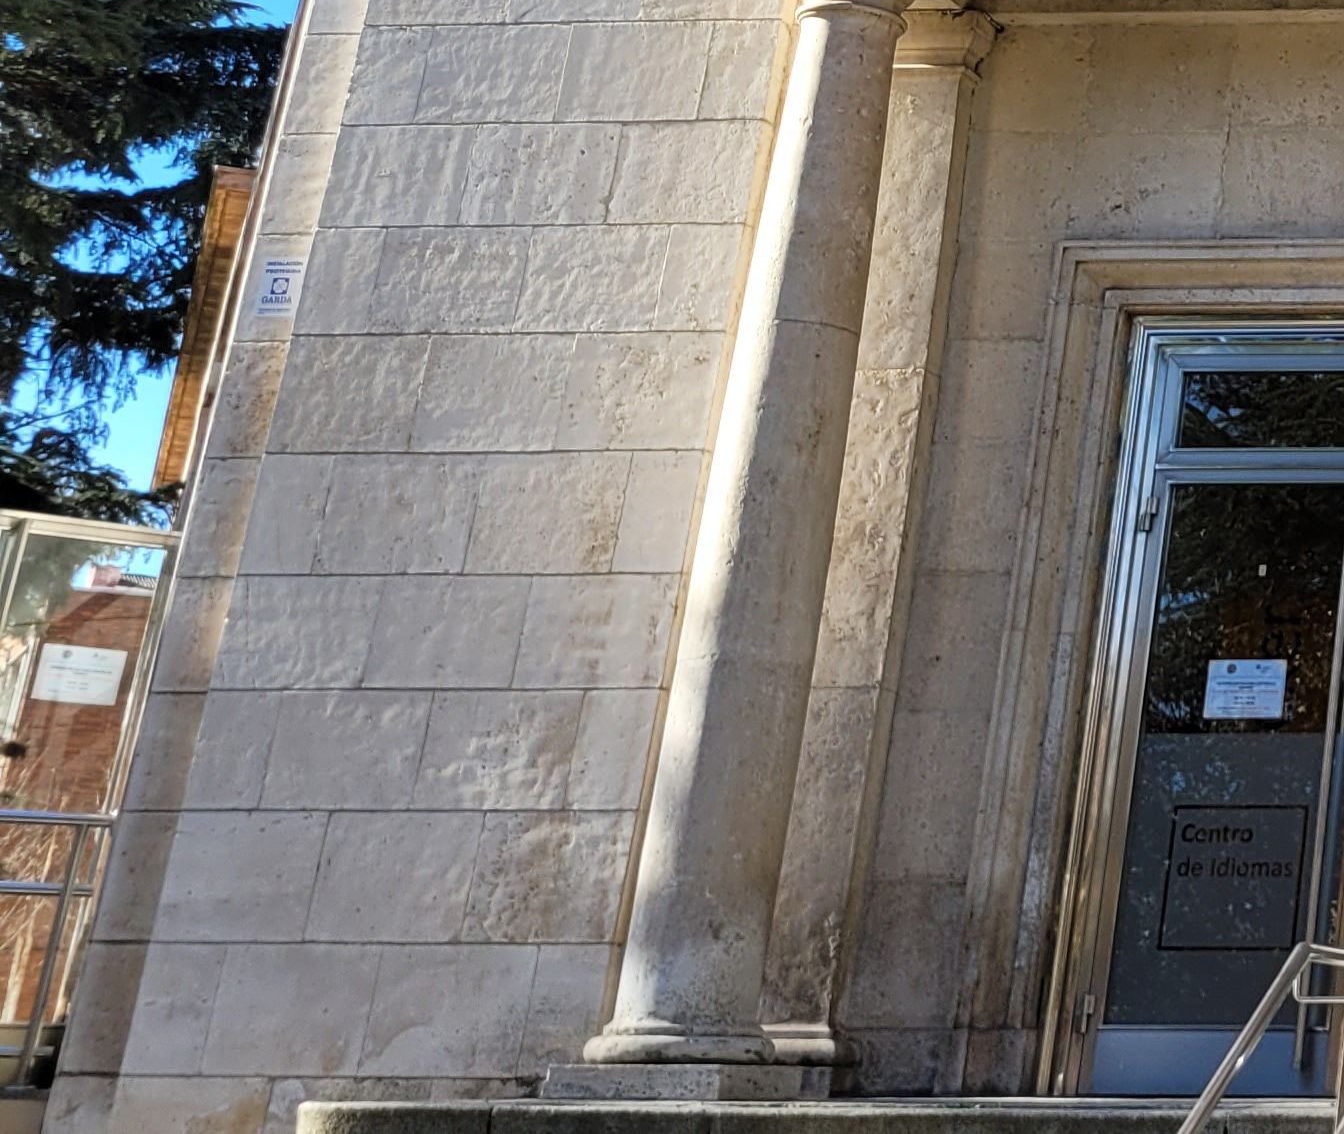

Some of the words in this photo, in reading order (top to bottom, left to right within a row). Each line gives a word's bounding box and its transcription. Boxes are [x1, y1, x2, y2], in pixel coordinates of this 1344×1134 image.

[1181, 823, 1255, 844] Centro
[1176, 857, 1203, 878] de
[1210, 856, 1293, 878] Idiomas
